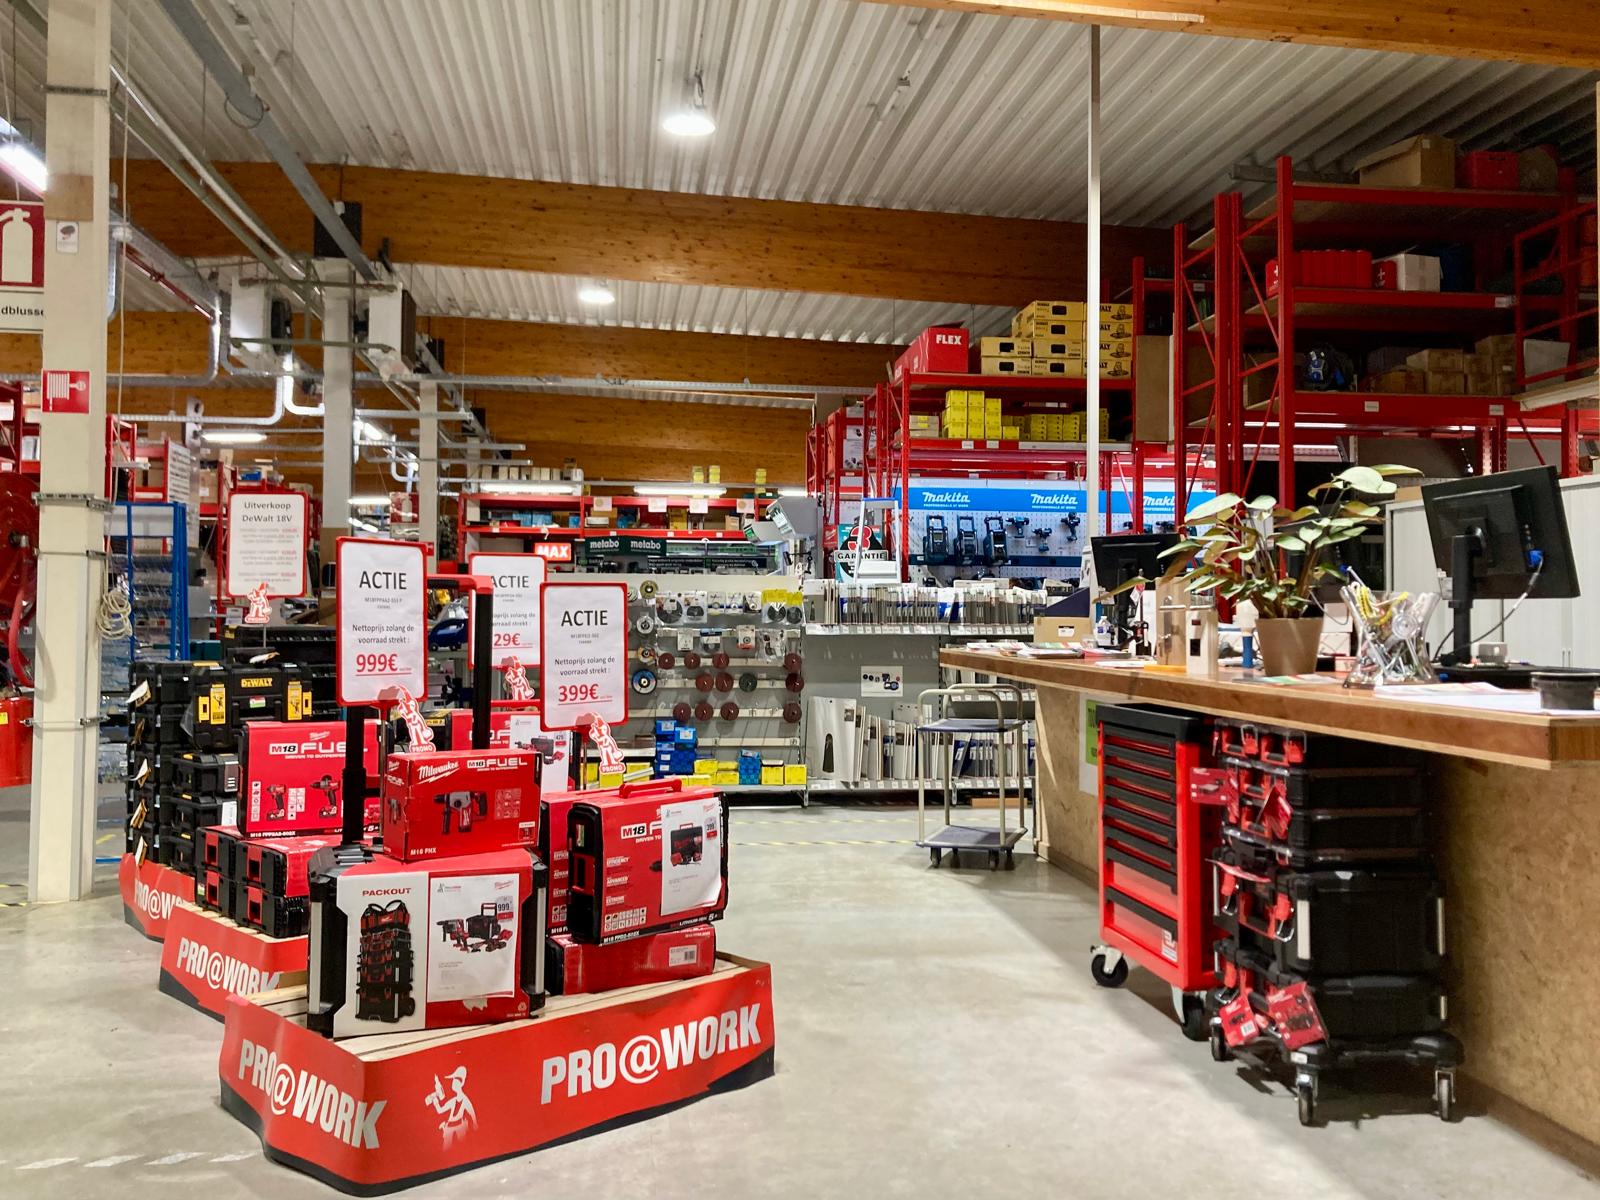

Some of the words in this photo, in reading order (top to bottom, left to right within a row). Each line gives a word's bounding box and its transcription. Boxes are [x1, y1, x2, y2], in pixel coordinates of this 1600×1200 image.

[936, 334, 961, 345] FLEX
[244, 502, 292, 510] Uitverkoop
[1143, 496, 1175, 506] maki
[590, 539, 620, 549] metabo
[630, 539, 661, 550] metabo
[536, 545, 568, 557] MAX
[359, 571, 407, 590] ACTIE
[490, 575, 530, 588] ACTIE
[561, 610, 608, 626] ACTIE
[353, 624, 384, 632] Nettoprijs
[386, 625, 405, 633] zolang
[407, 624, 414, 632] de
[358, 636, 387, 644] voorraad
[493, 633, 521, 647] 29€
[356, 653, 398, 673] 999€
[555, 658, 586, 666] Nettoprijs
[560, 668, 588, 676] voorraad
[558, 683, 599, 702] 399€
[271, 745, 297, 753] M18
[301, 742, 346, 753] FUE
[486, 757, 528, 767] FUEL
[417, 761, 459, 780] Milwaukee
[602, 764, 623, 773] PROMO
[622, 824, 646, 838] M18
[362, 888, 412, 896] PACKOUT
[497, 903, 510, 912] 999
[541, 1003, 761, 1104] PRO@WORK
[238, 1039, 387, 1149] PRO@WORK
